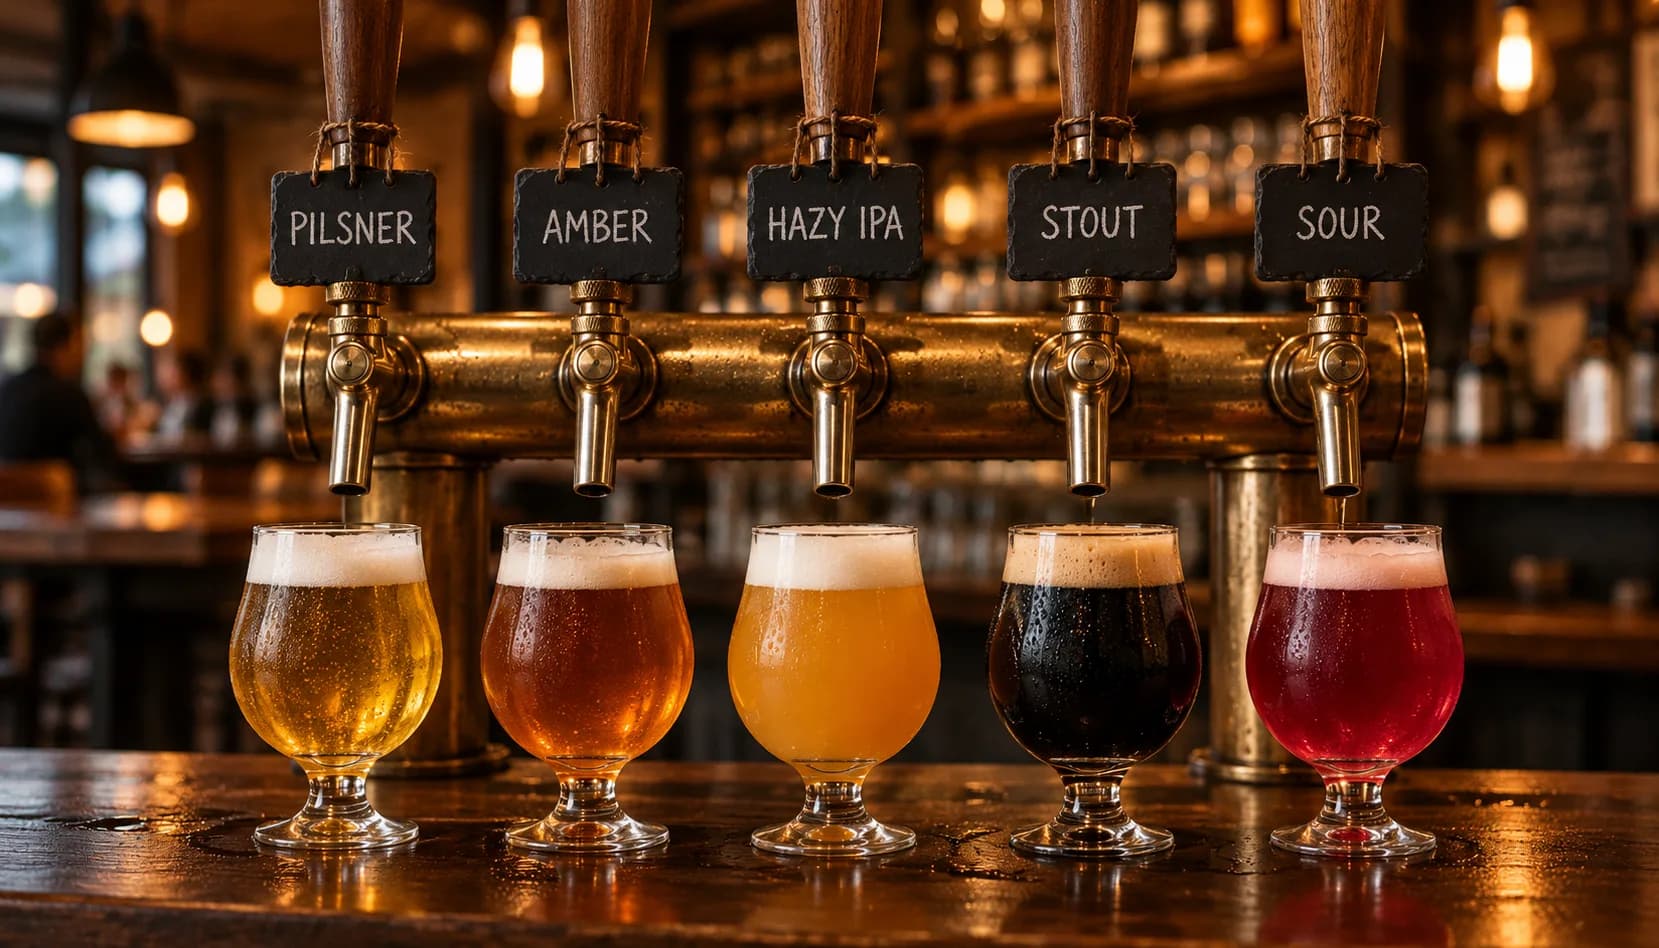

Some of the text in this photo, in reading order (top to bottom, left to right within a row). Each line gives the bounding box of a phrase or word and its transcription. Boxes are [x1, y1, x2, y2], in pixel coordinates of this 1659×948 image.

[290, 210, 417, 246] PILSNER
[542, 208, 653, 245] AMBER
[768, 205, 904, 241] HAZY IPA
[1041, 204, 1144, 240] STOUT
[1296, 205, 1385, 241] SOUR
